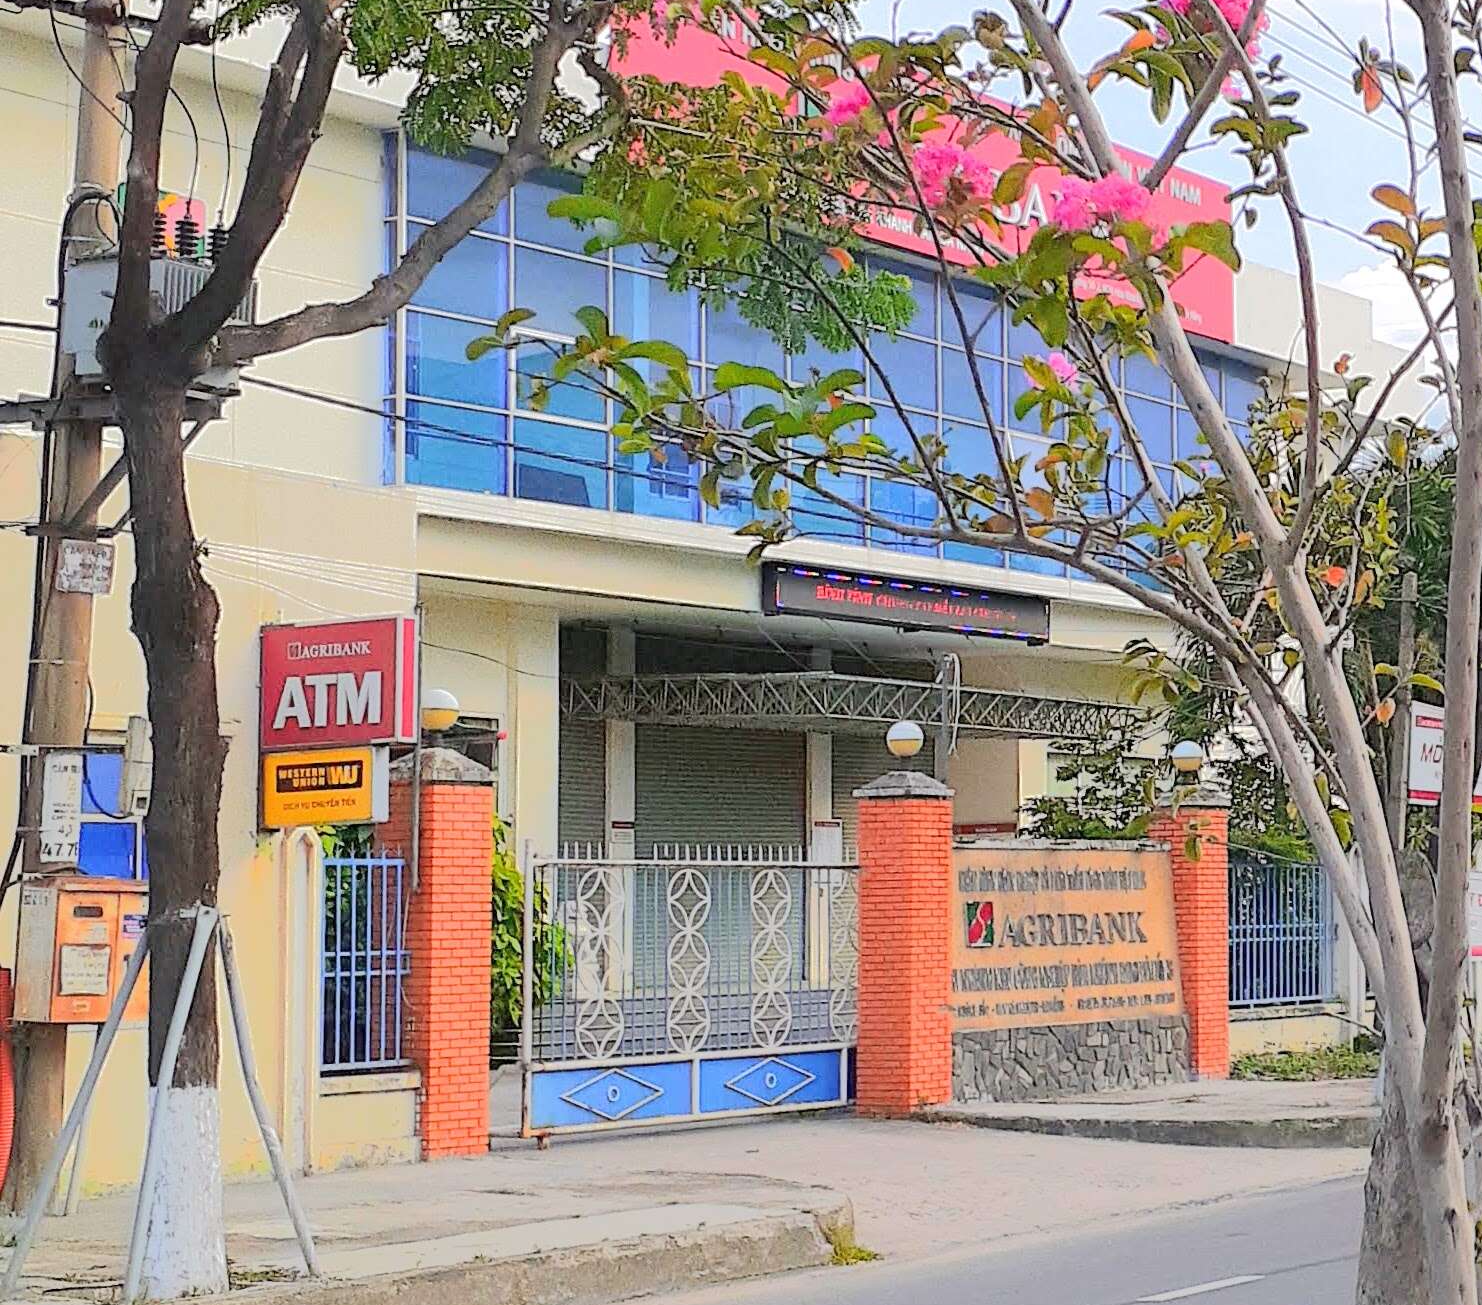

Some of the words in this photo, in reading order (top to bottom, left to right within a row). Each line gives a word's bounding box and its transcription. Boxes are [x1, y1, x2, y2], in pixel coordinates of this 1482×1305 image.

[1168, 178, 1201, 206] NAM
[299, 641, 371, 659] AGRIBANK
[272, 670, 383, 730] ATM
[279, 766, 326, 780] WESTERN
[292, 776, 326, 788] UNION
[328, 764, 359, 785] WU
[998, 911, 1148, 948] AGRIBANK
